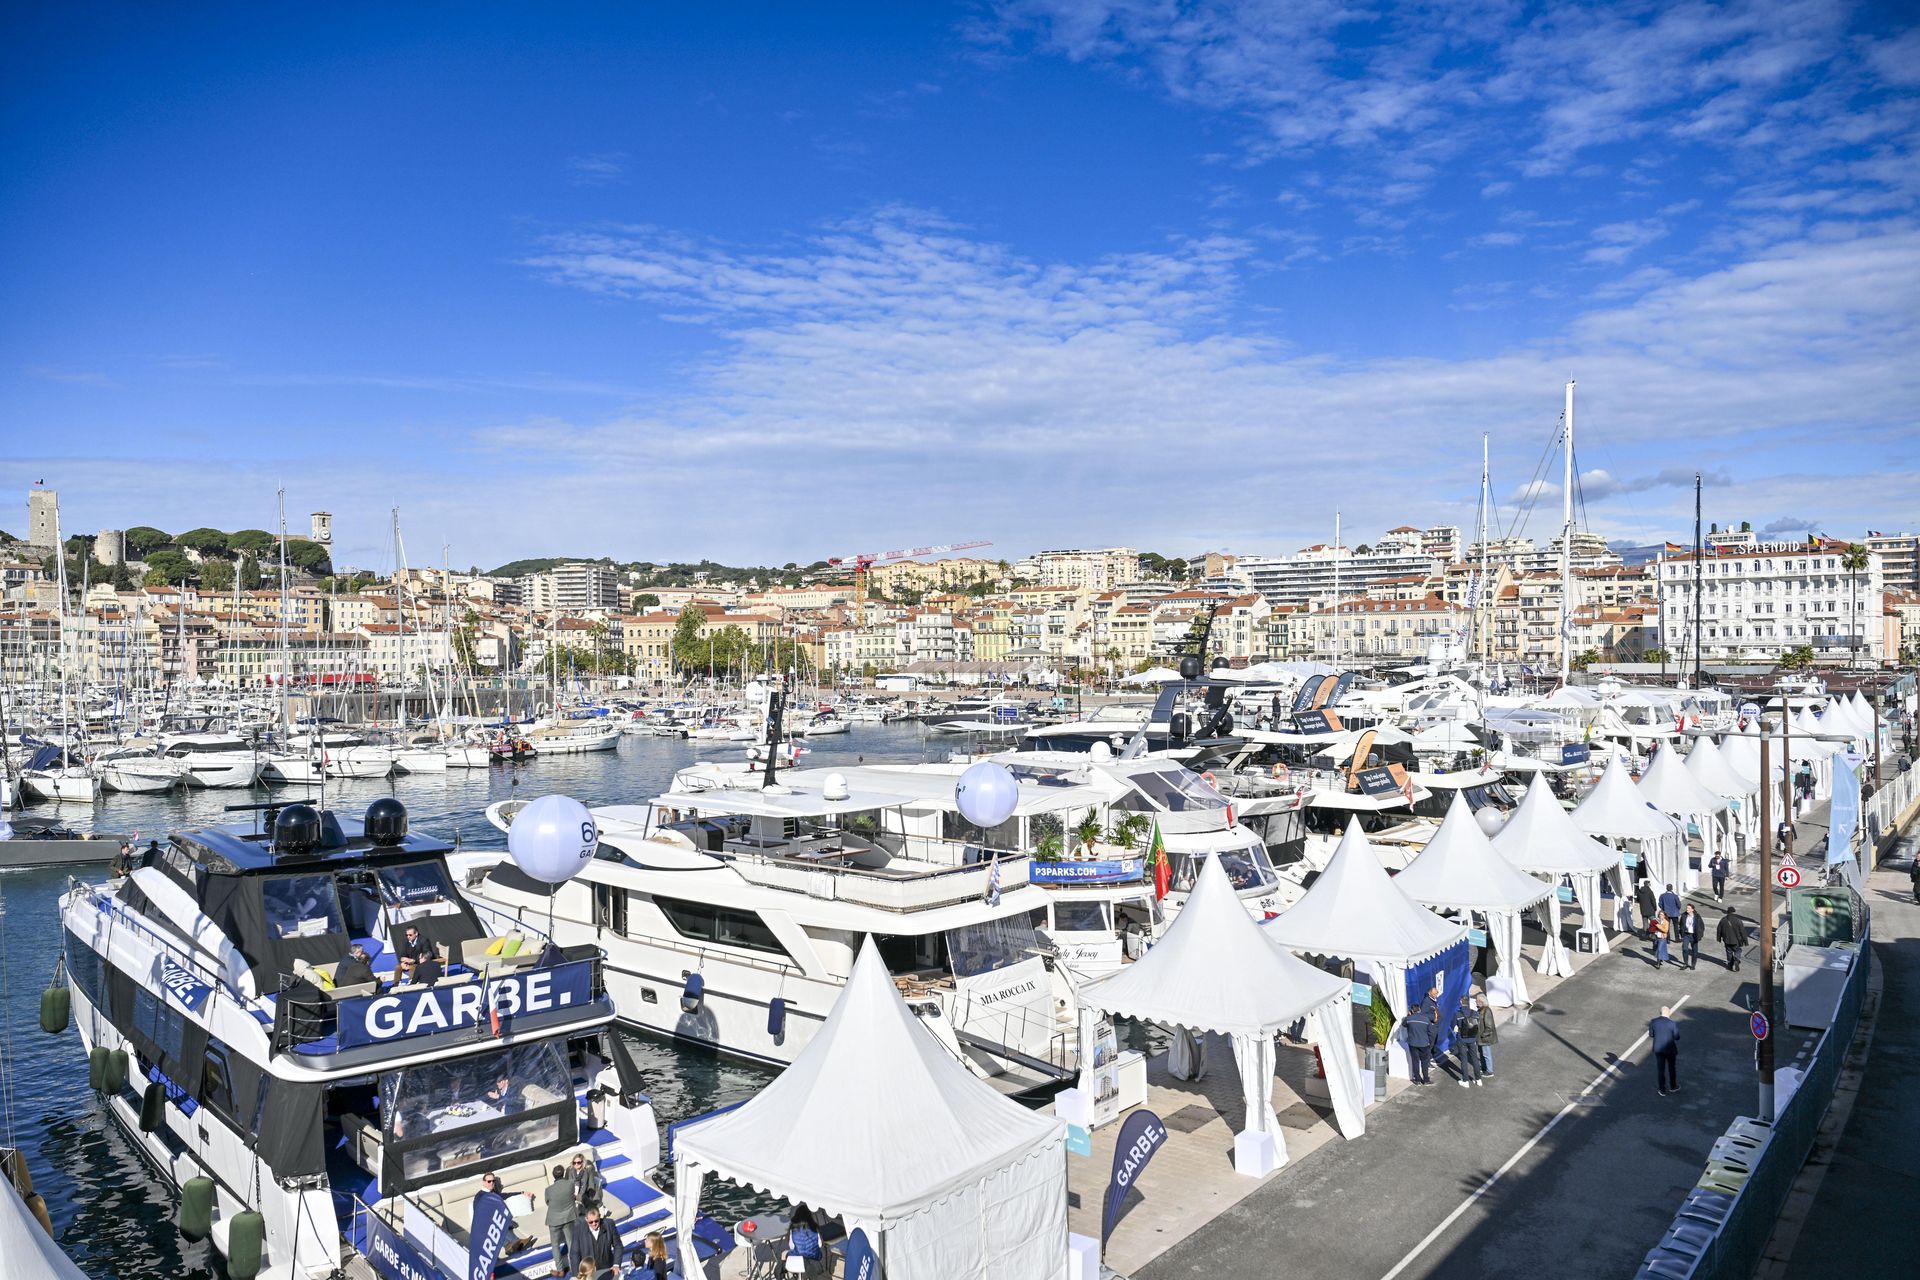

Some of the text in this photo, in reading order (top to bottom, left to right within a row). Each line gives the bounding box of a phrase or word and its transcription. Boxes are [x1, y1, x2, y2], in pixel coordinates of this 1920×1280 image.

[1739, 541, 1800, 554] SPLENDID
[1035, 867, 1097, 877] P3PARKS.COM
[1072, 947, 1099, 960] Jersey
[364, 971, 572, 1039] GARBE.
[980, 980, 1036, 1006] MIA ROCCA IX
[1116, 1124, 1165, 1187] GARBE.
[374, 1234, 400, 1270] GARBE
[400, 1261, 410, 1280] at
[473, 1208, 509, 1280] GARBE.
[526, 1263, 553, 1279] ANNES
